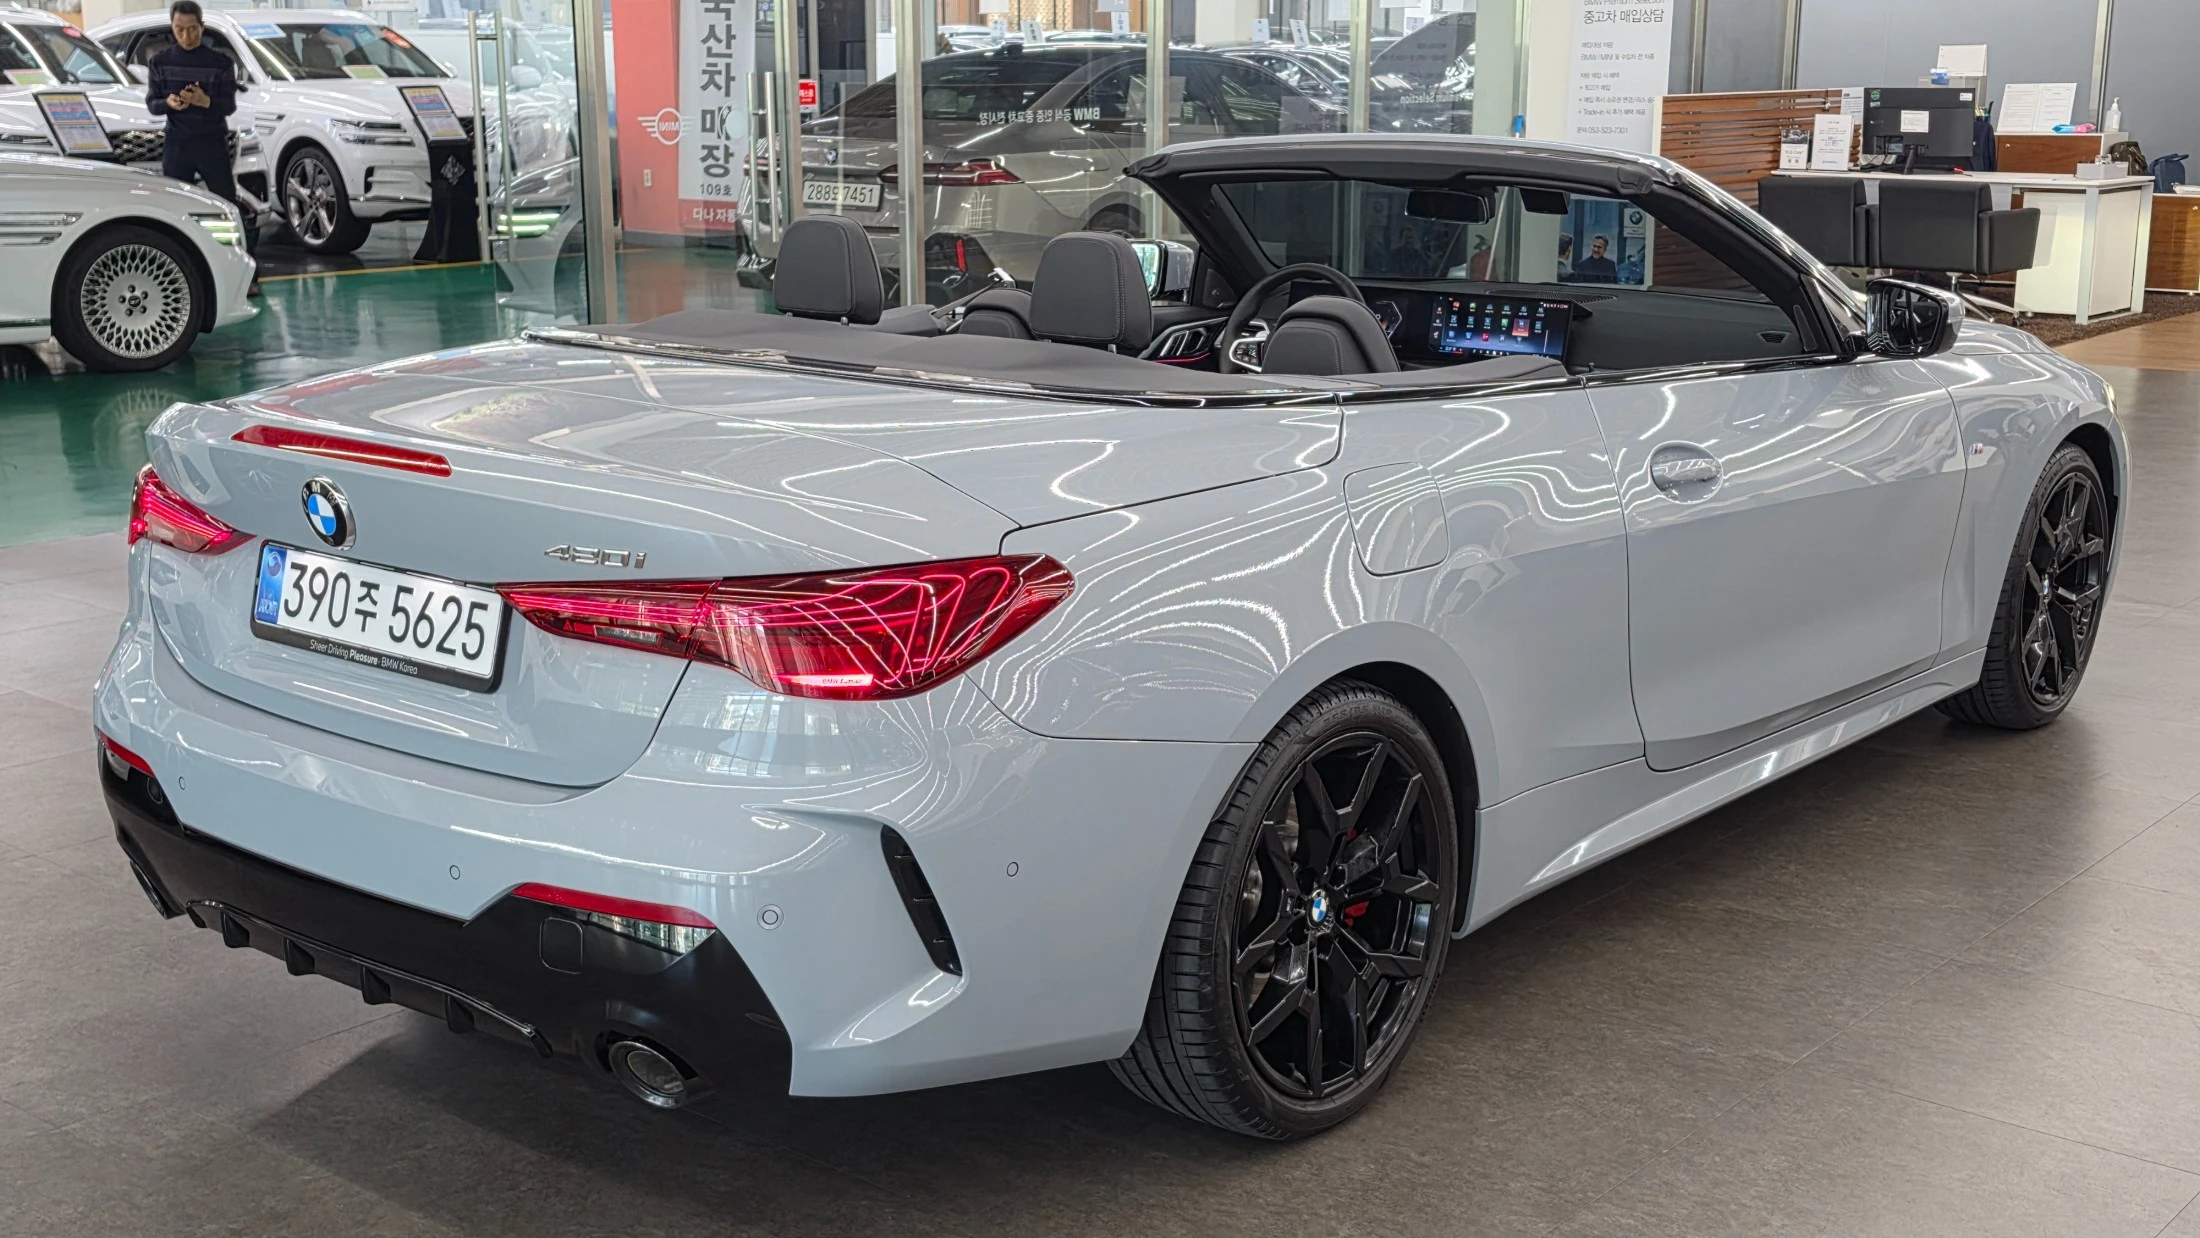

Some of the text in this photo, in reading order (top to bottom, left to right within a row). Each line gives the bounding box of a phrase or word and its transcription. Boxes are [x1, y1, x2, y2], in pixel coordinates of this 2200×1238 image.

[1584, 9, 1664, 24] 중고차 매입상담
[699, 106, 734, 178] 매장
[700, 183, 732, 196] 109호
[843, 186, 873, 204] 7451
[544, 544, 647, 569] 430i
[284, 561, 488, 661] 390주 5625
[310, 639, 418, 675] Sheer Driving Pleasure BMW Korea
